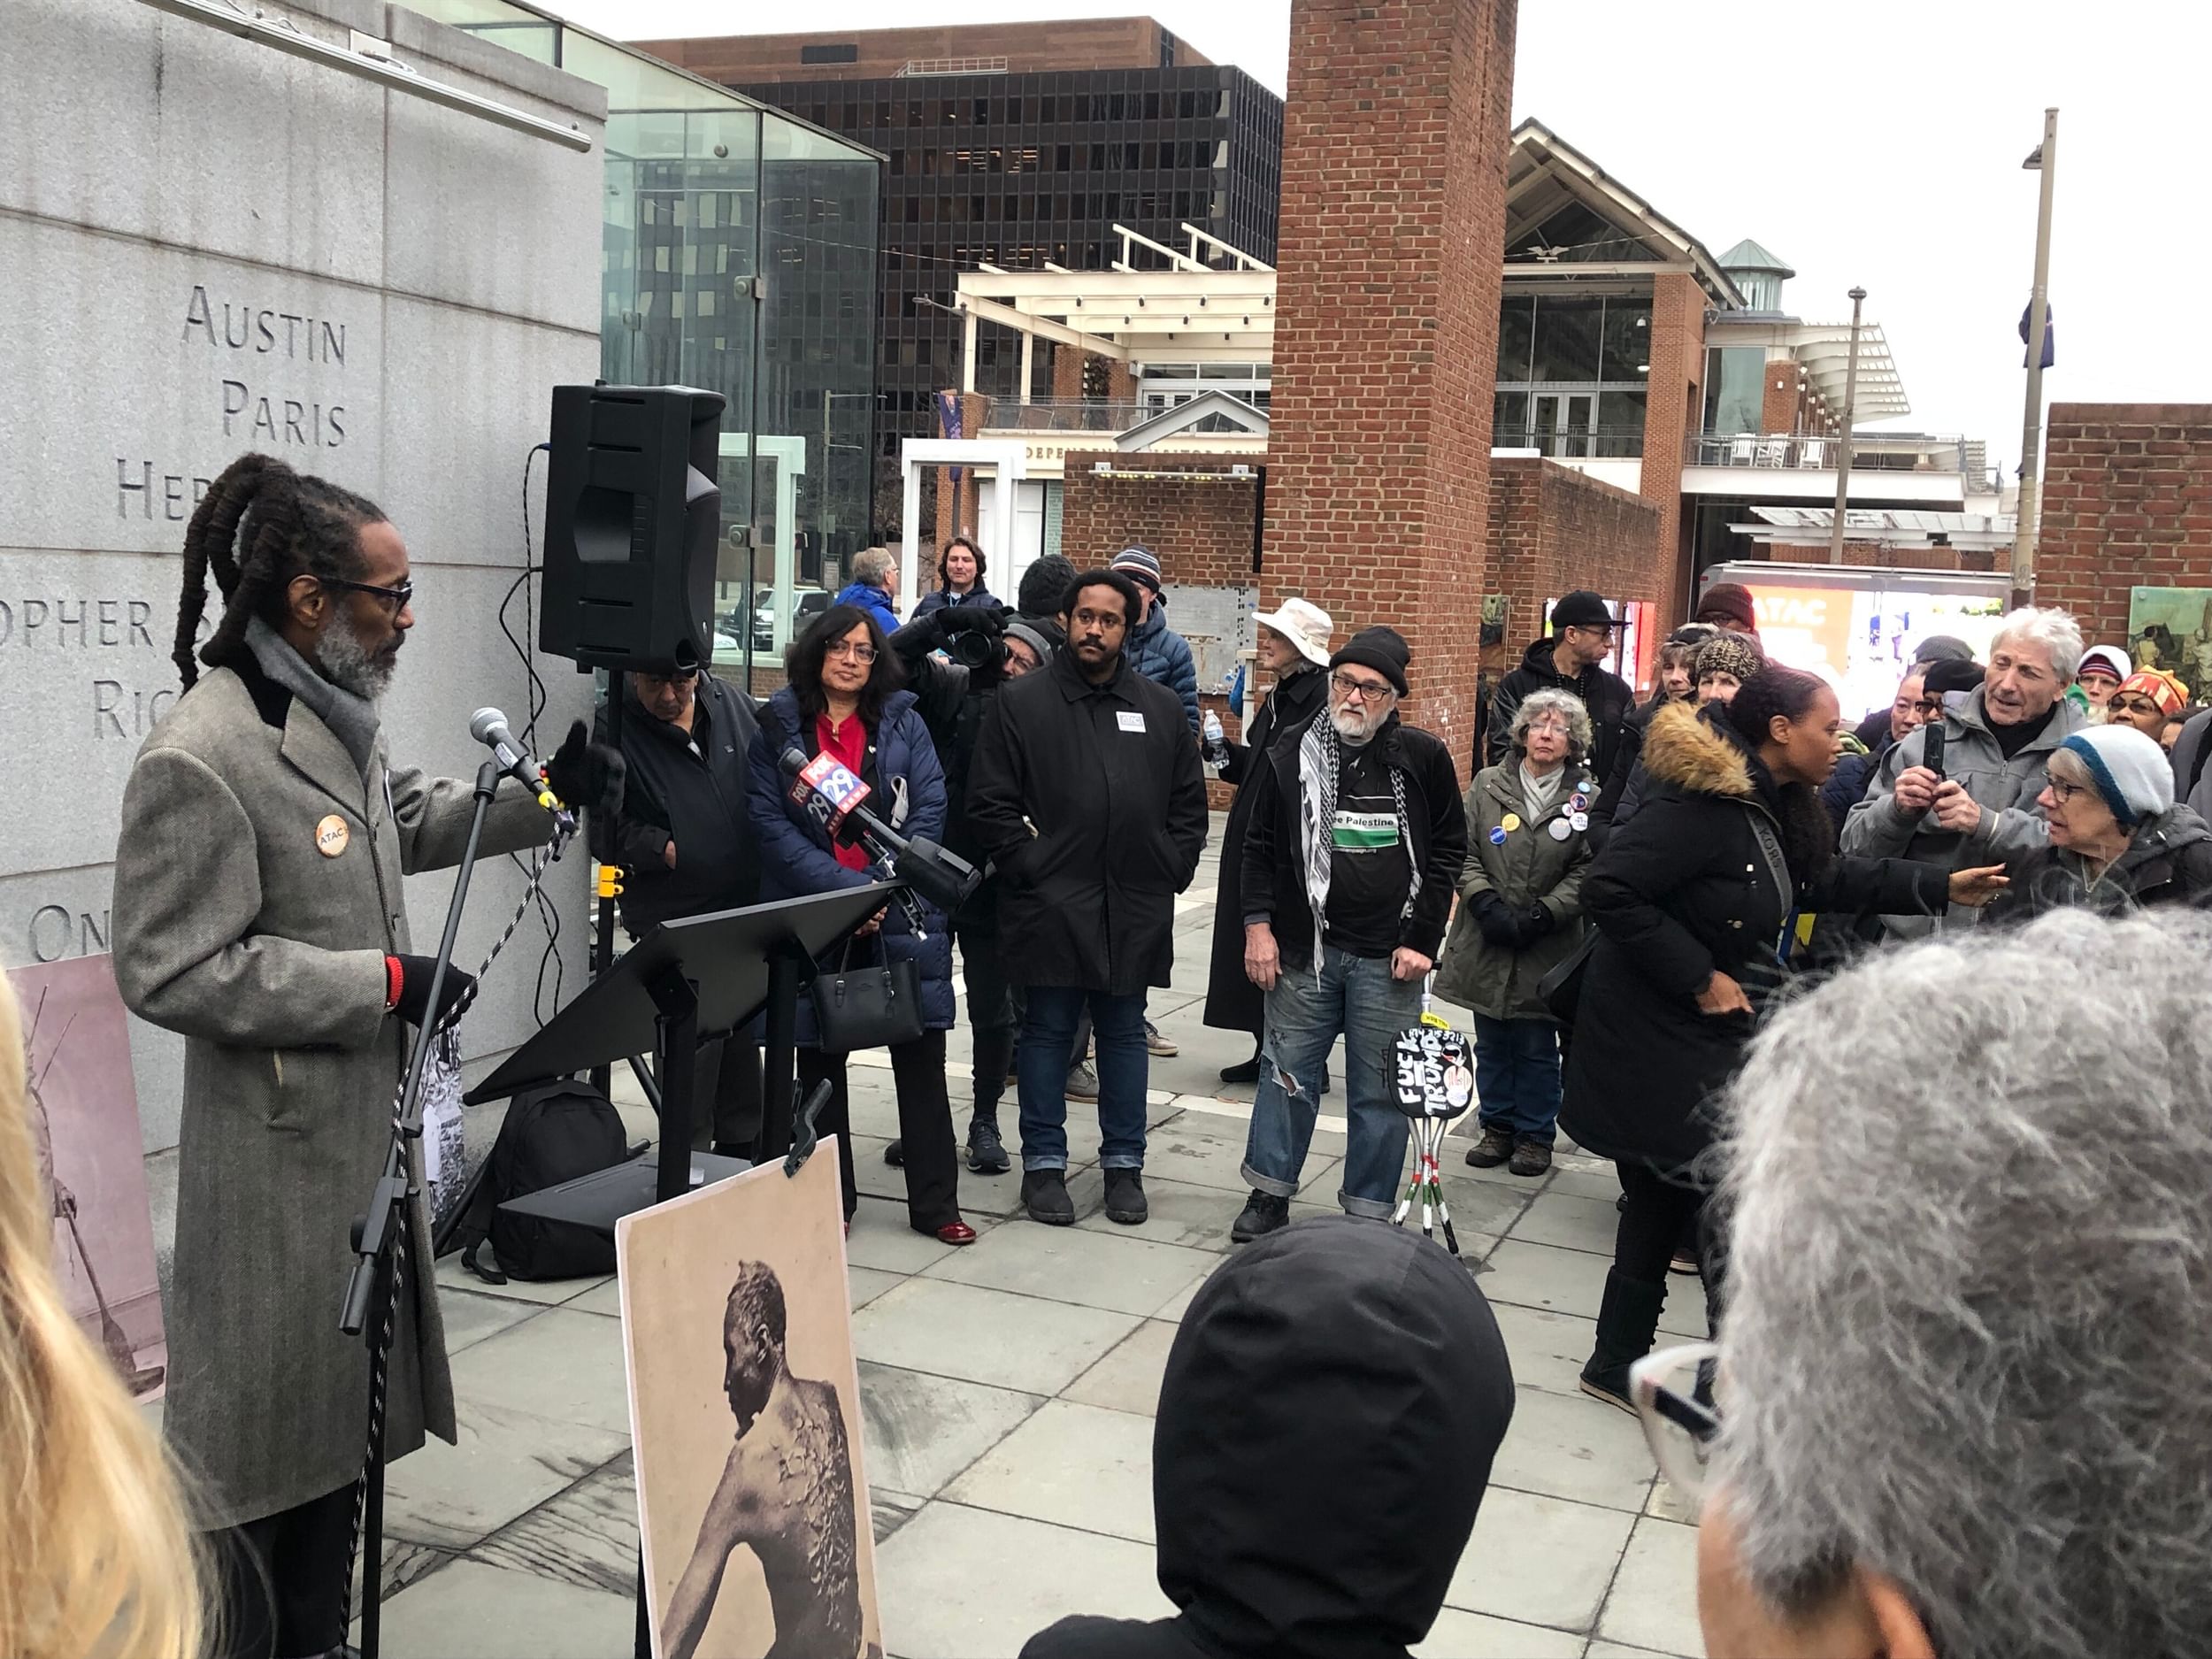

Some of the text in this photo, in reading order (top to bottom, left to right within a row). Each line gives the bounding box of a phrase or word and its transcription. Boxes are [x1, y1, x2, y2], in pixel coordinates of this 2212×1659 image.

[180, 285, 346, 366] AUSTIN
[222, 380, 345, 448] PARIS
[792, 780, 810, 803] FOX
[807, 793, 832, 825] 29
[806, 756, 868, 810] FOX 29 NEWS
[1346, 817, 1394, 826] Palestine
[1396, 1030, 1421, 1104] FUCK
[1420, 1033, 1449, 1116] TRUMP
